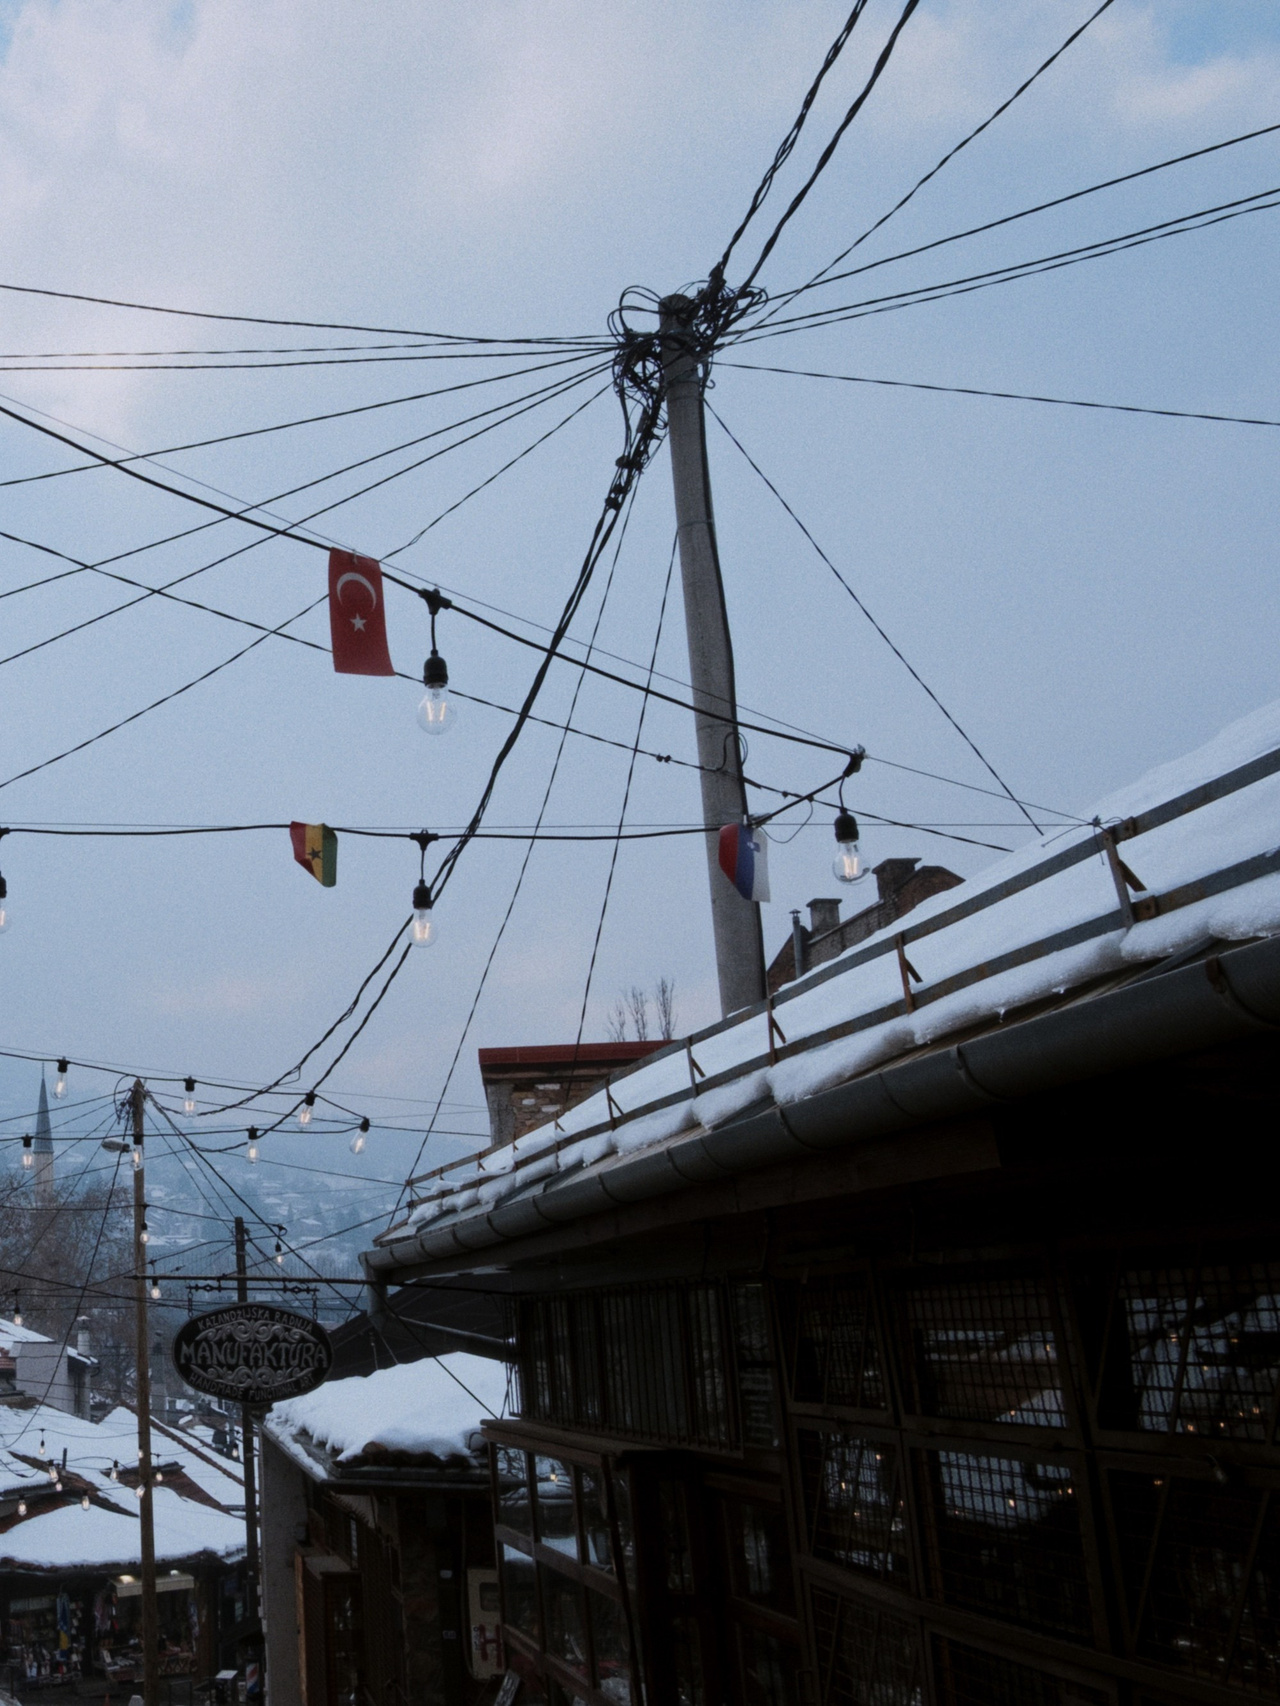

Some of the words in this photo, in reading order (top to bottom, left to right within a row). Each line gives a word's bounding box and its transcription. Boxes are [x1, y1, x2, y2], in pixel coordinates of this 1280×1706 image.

[275, 1311, 313, 1333] RADNJA
[180, 1341, 328, 1368] MANUFAKTURA
[190, 1373, 245, 1399] HANDMADE
[248, 1383, 297, 1401] FUNCTIONAL
[300, 1373, 316, 1390] ART
